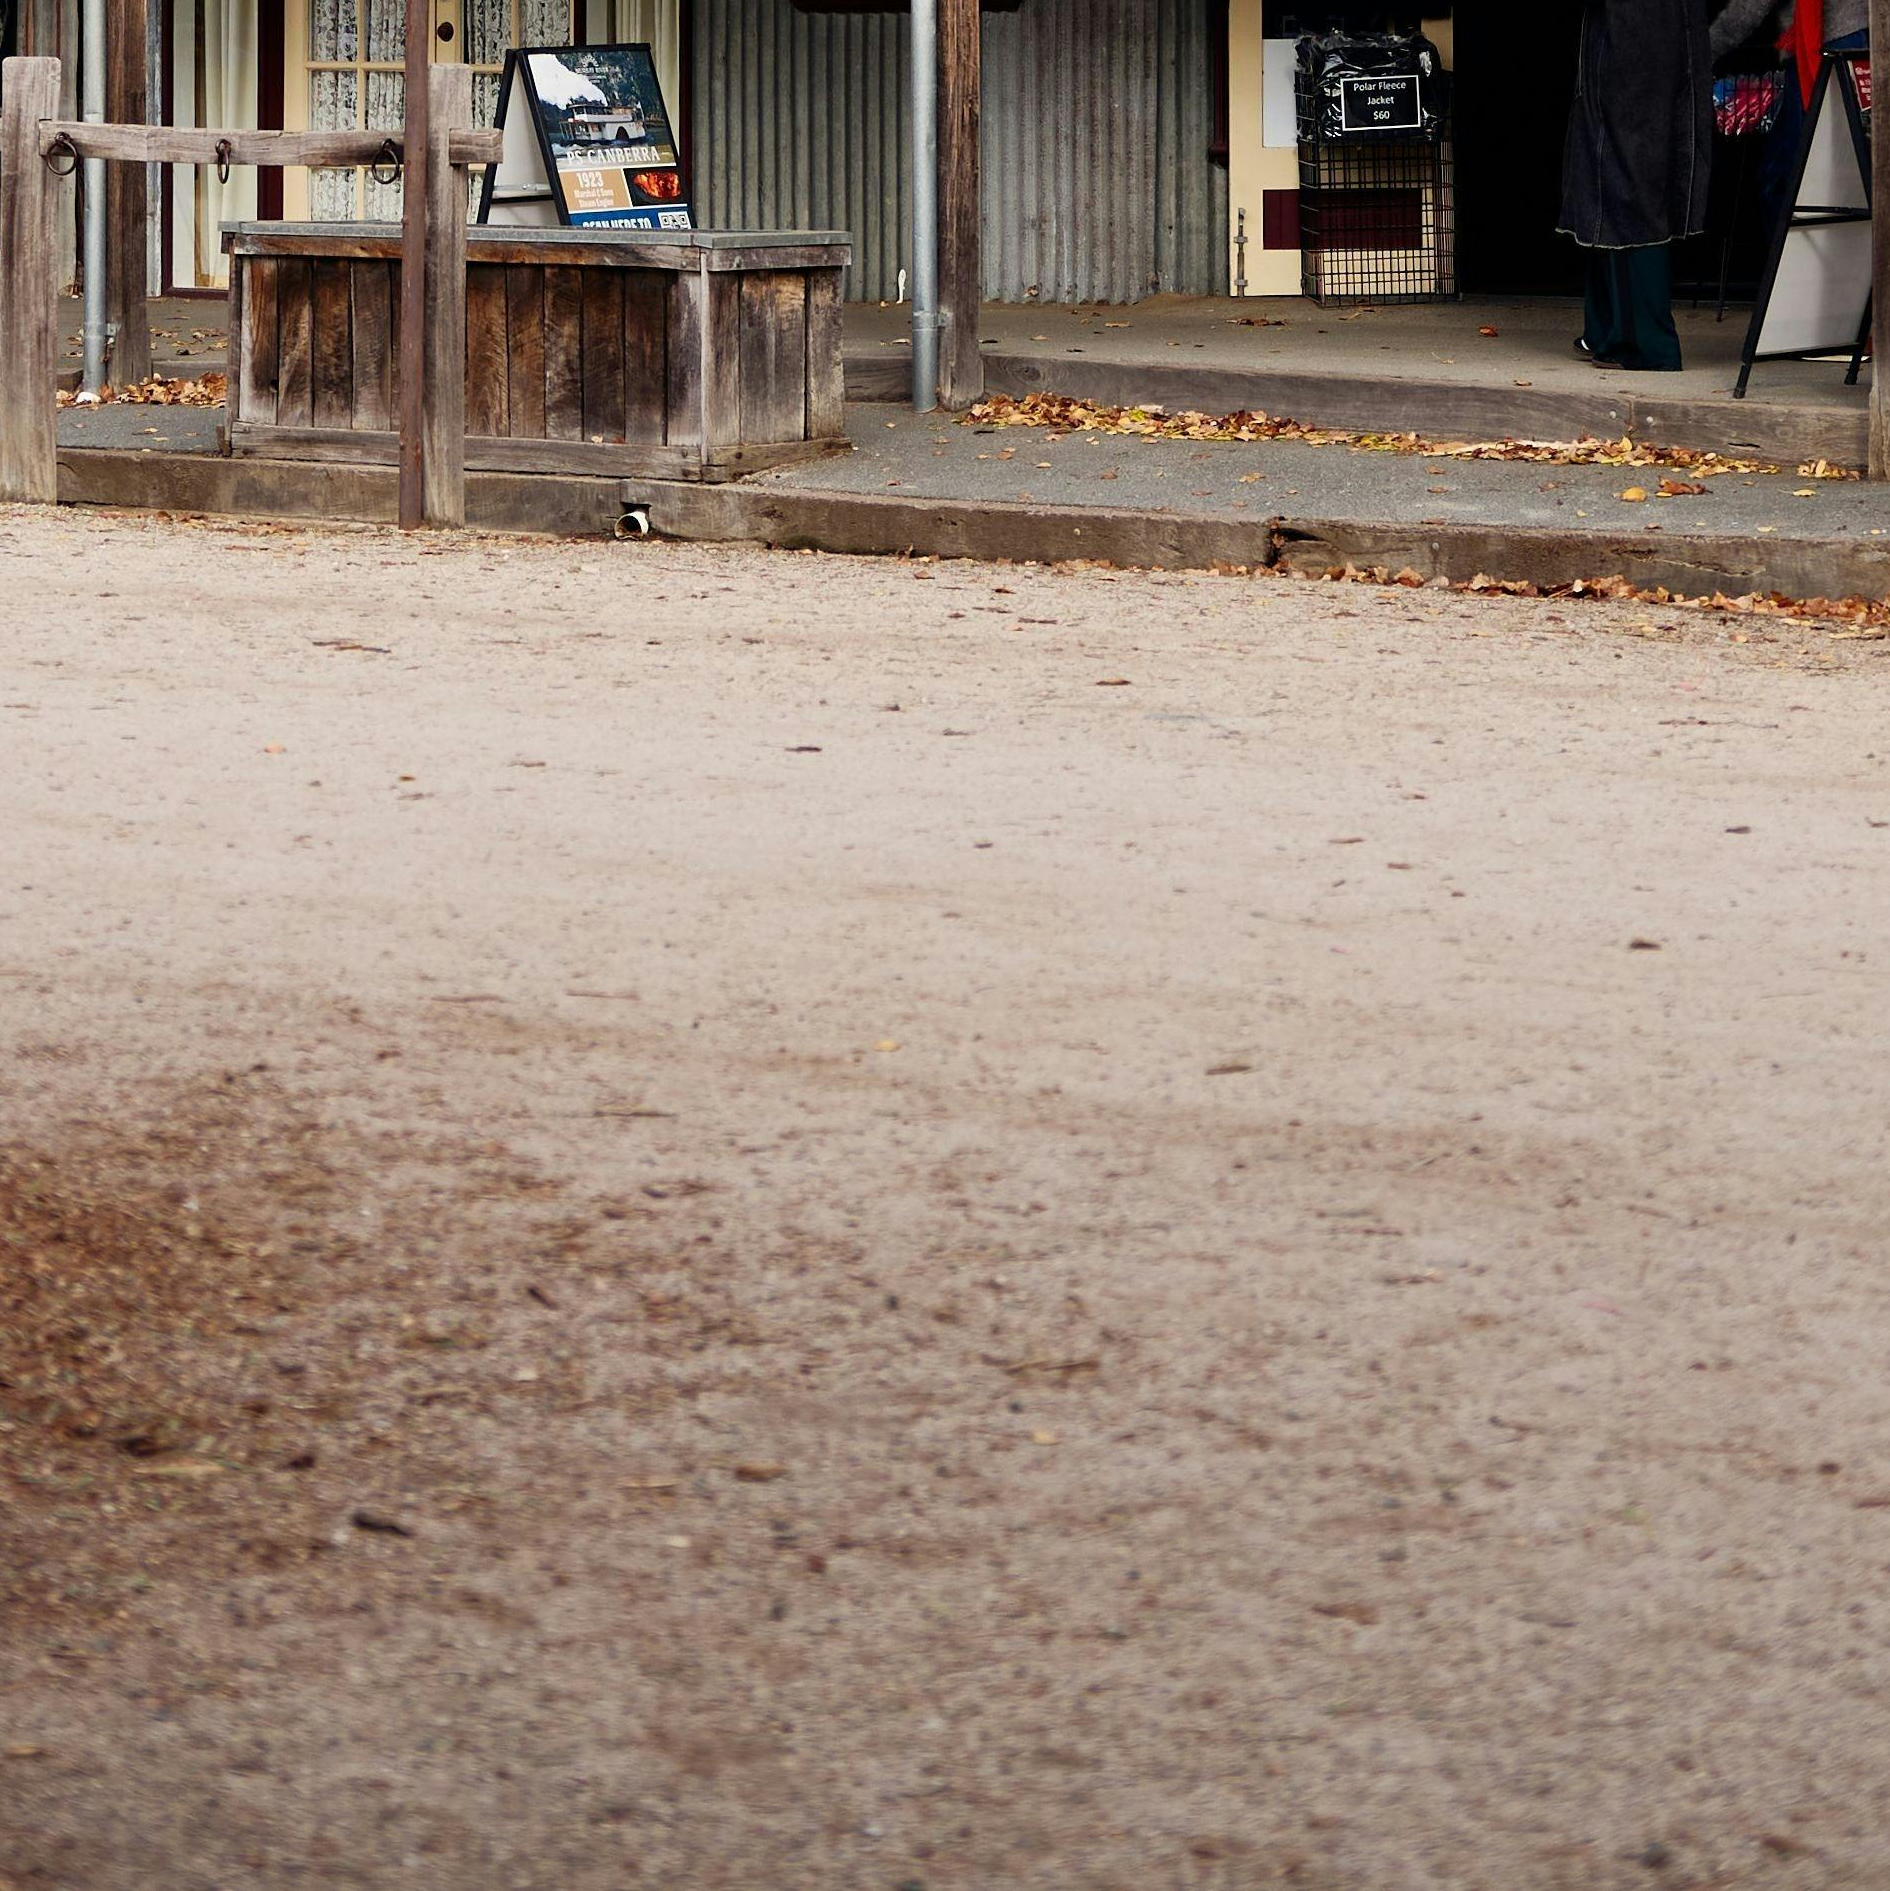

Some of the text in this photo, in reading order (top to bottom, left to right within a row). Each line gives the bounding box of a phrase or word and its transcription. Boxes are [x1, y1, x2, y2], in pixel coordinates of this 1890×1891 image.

[1354, 81, 1408, 92] Polar Fleece
[1367, 95, 1395, 106] Jacket
[1373, 110, 1391, 120] $60
[566, 145, 661, 164] PS CANBERRA
[576, 171, 605, 188] 1923
